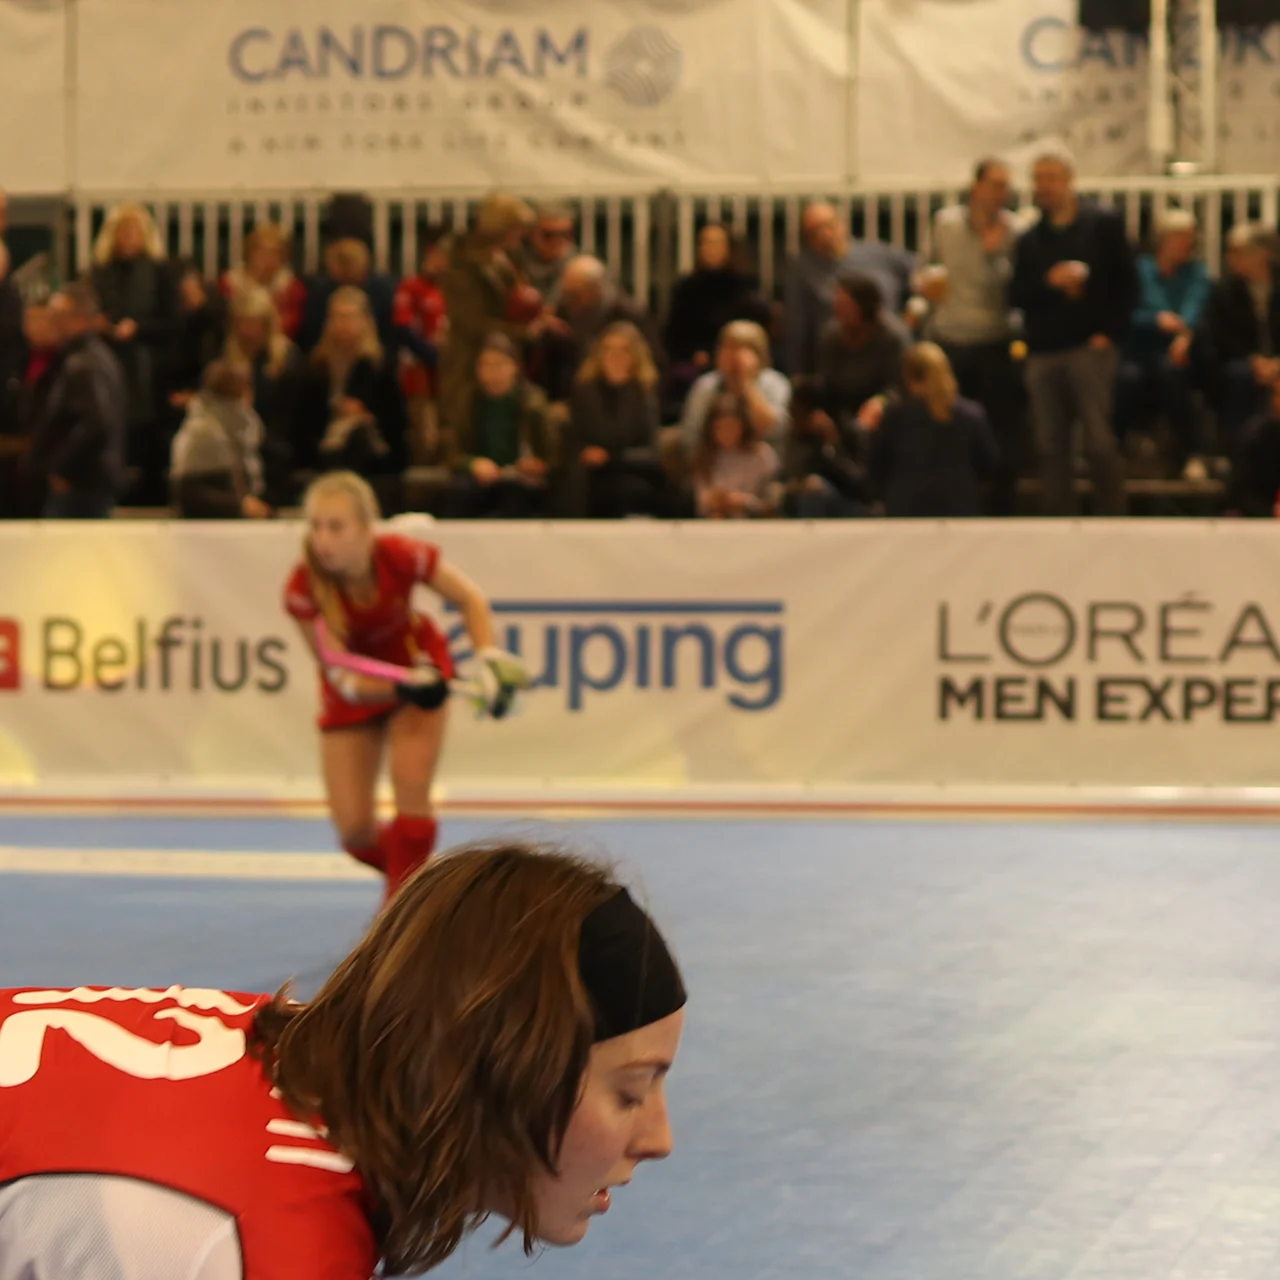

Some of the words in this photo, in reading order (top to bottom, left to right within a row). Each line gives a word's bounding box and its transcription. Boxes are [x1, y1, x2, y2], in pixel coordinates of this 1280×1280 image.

[227, 22, 589, 85] CANDRIAM
[42, 614, 289, 693] Belfius
[938, 674, 1078, 722] MEN
